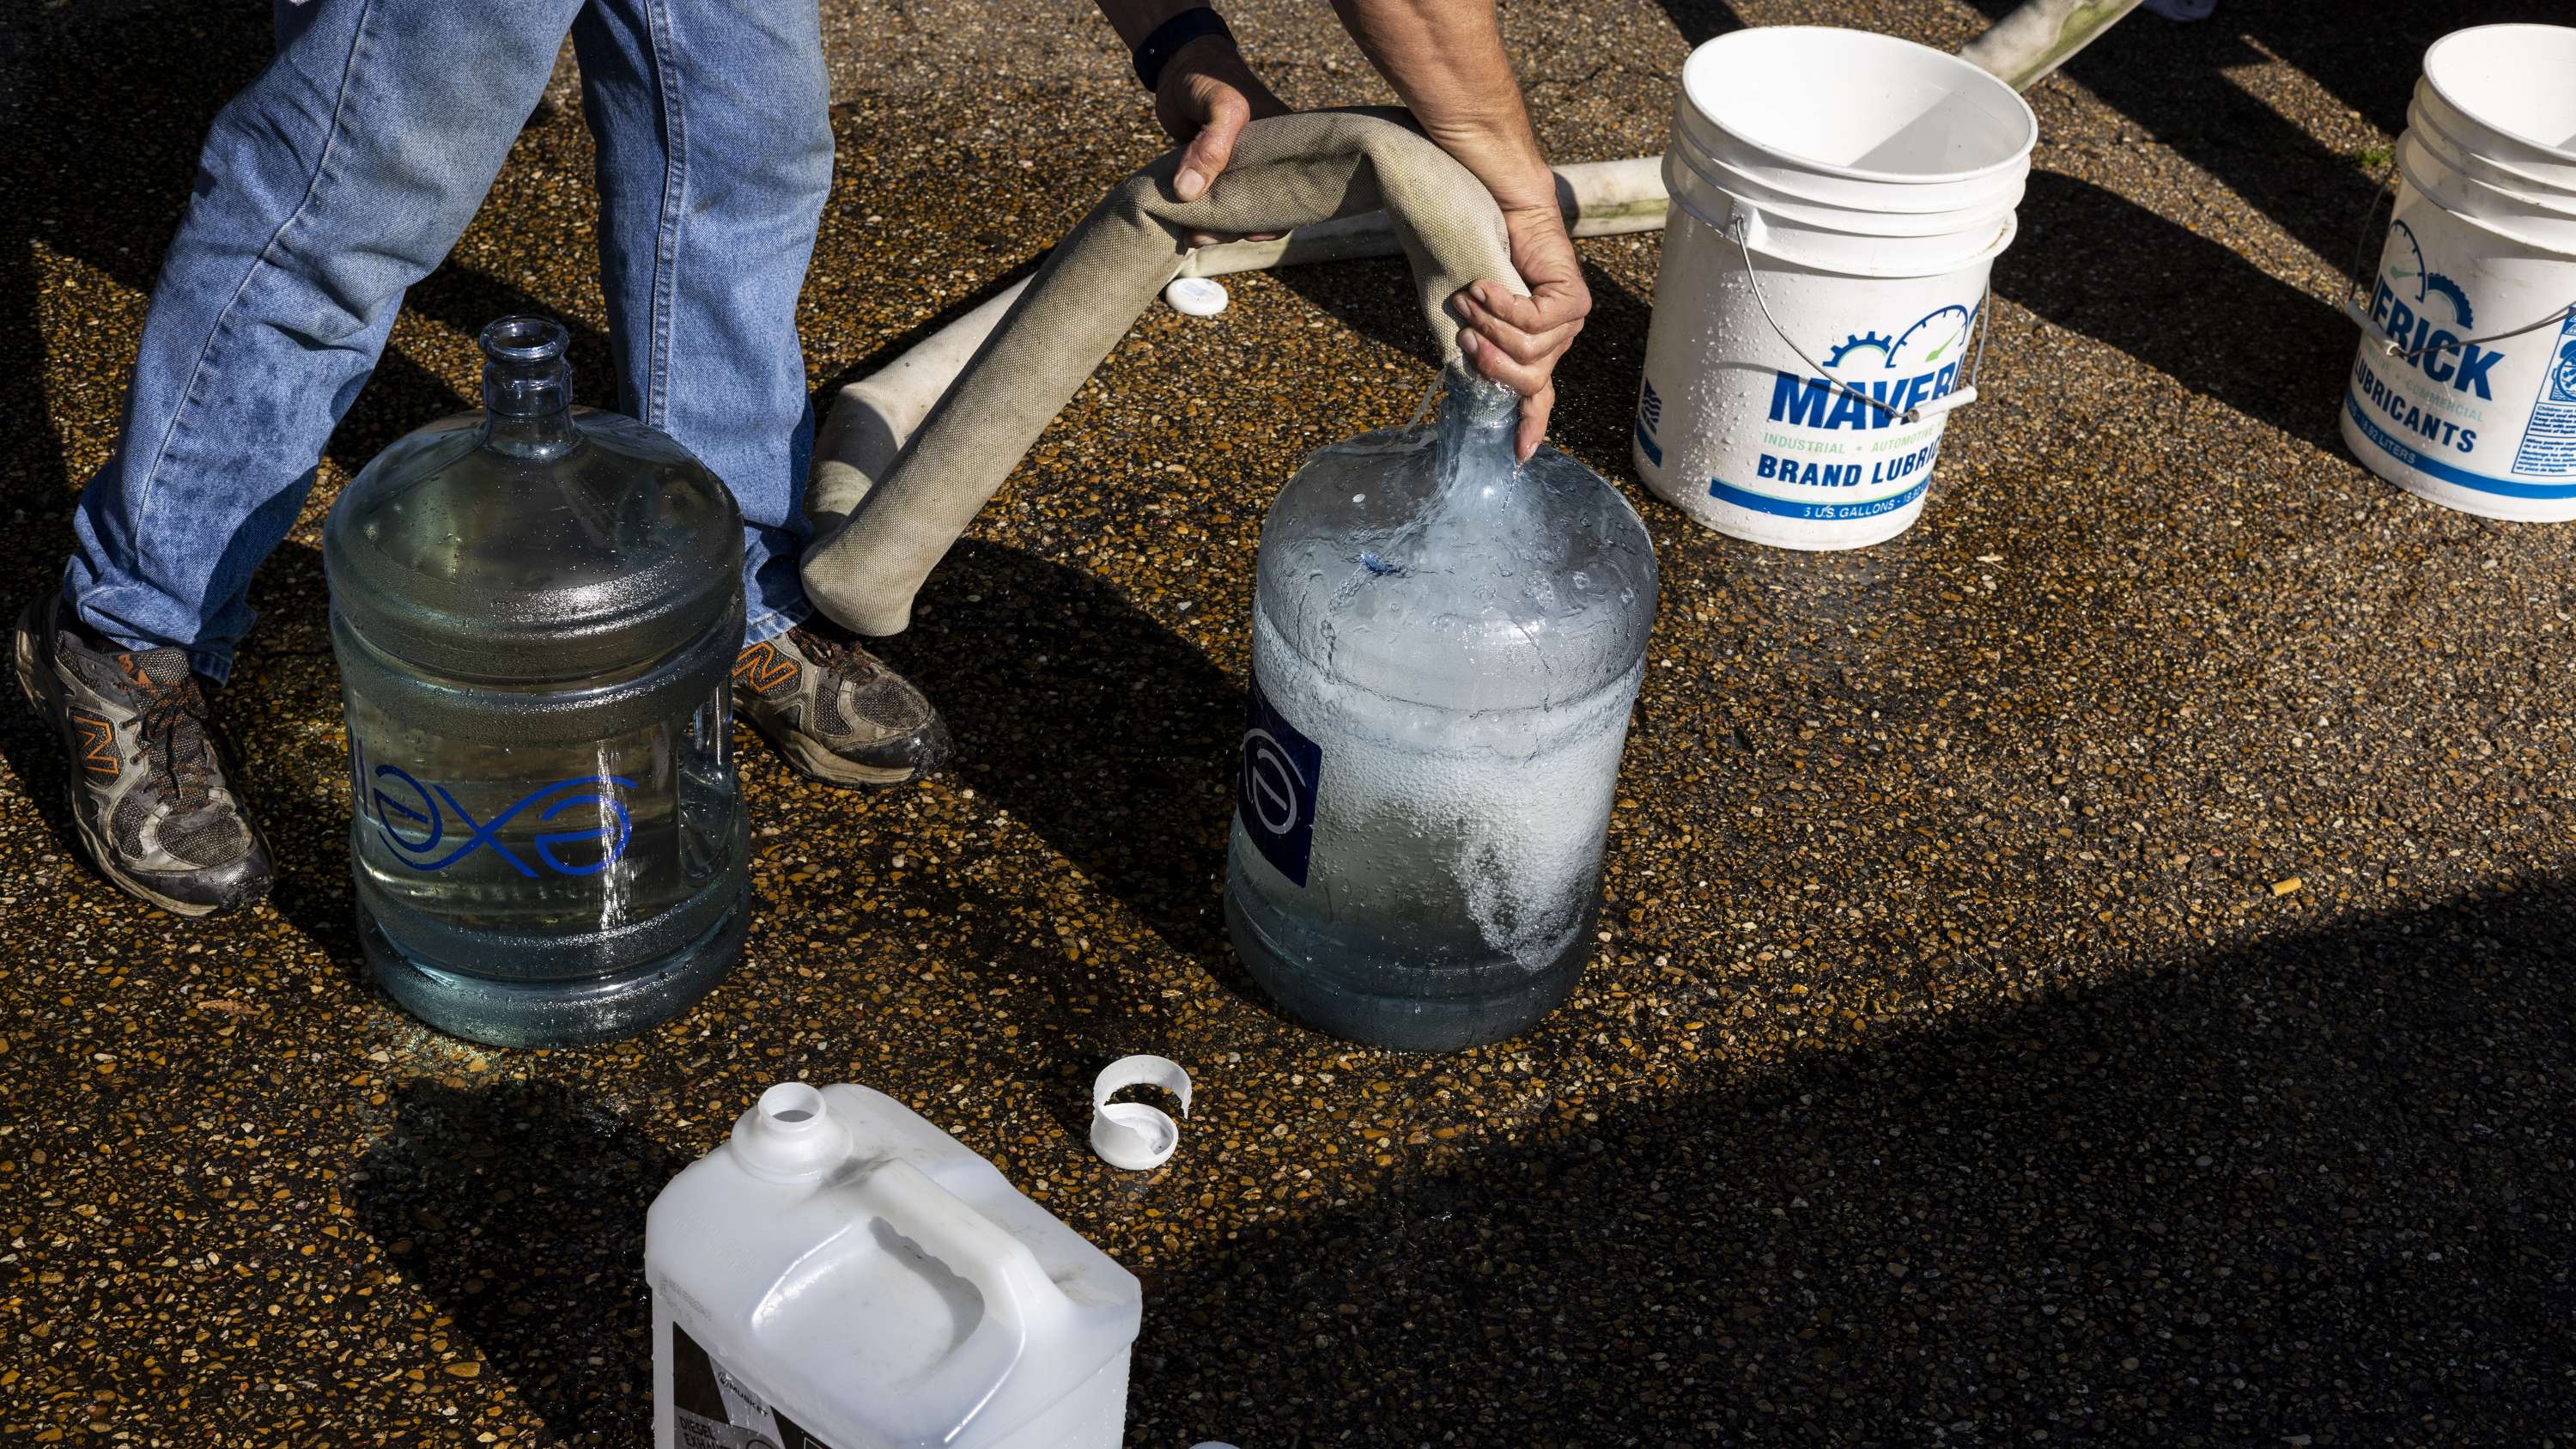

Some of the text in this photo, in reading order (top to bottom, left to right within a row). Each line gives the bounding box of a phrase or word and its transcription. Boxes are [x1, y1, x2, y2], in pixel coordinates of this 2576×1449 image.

[2354, 350, 2477, 454] LUBRICANTS
[2405, 379, 2484, 423] COMMERCIAL
[1764, 423, 1934, 454] INDUSTRIAL AUTOMOTIVE
[2379, 435, 2416, 464] LITERS
[1757, 454, 1862, 487] BRAND
[1815, 507, 1836, 518] U.S.
[1839, 499, 1895, 518] GALLONS
[729, 1383, 769, 1417] MUSKET
[678, 1416, 716, 1440] DIESEL
